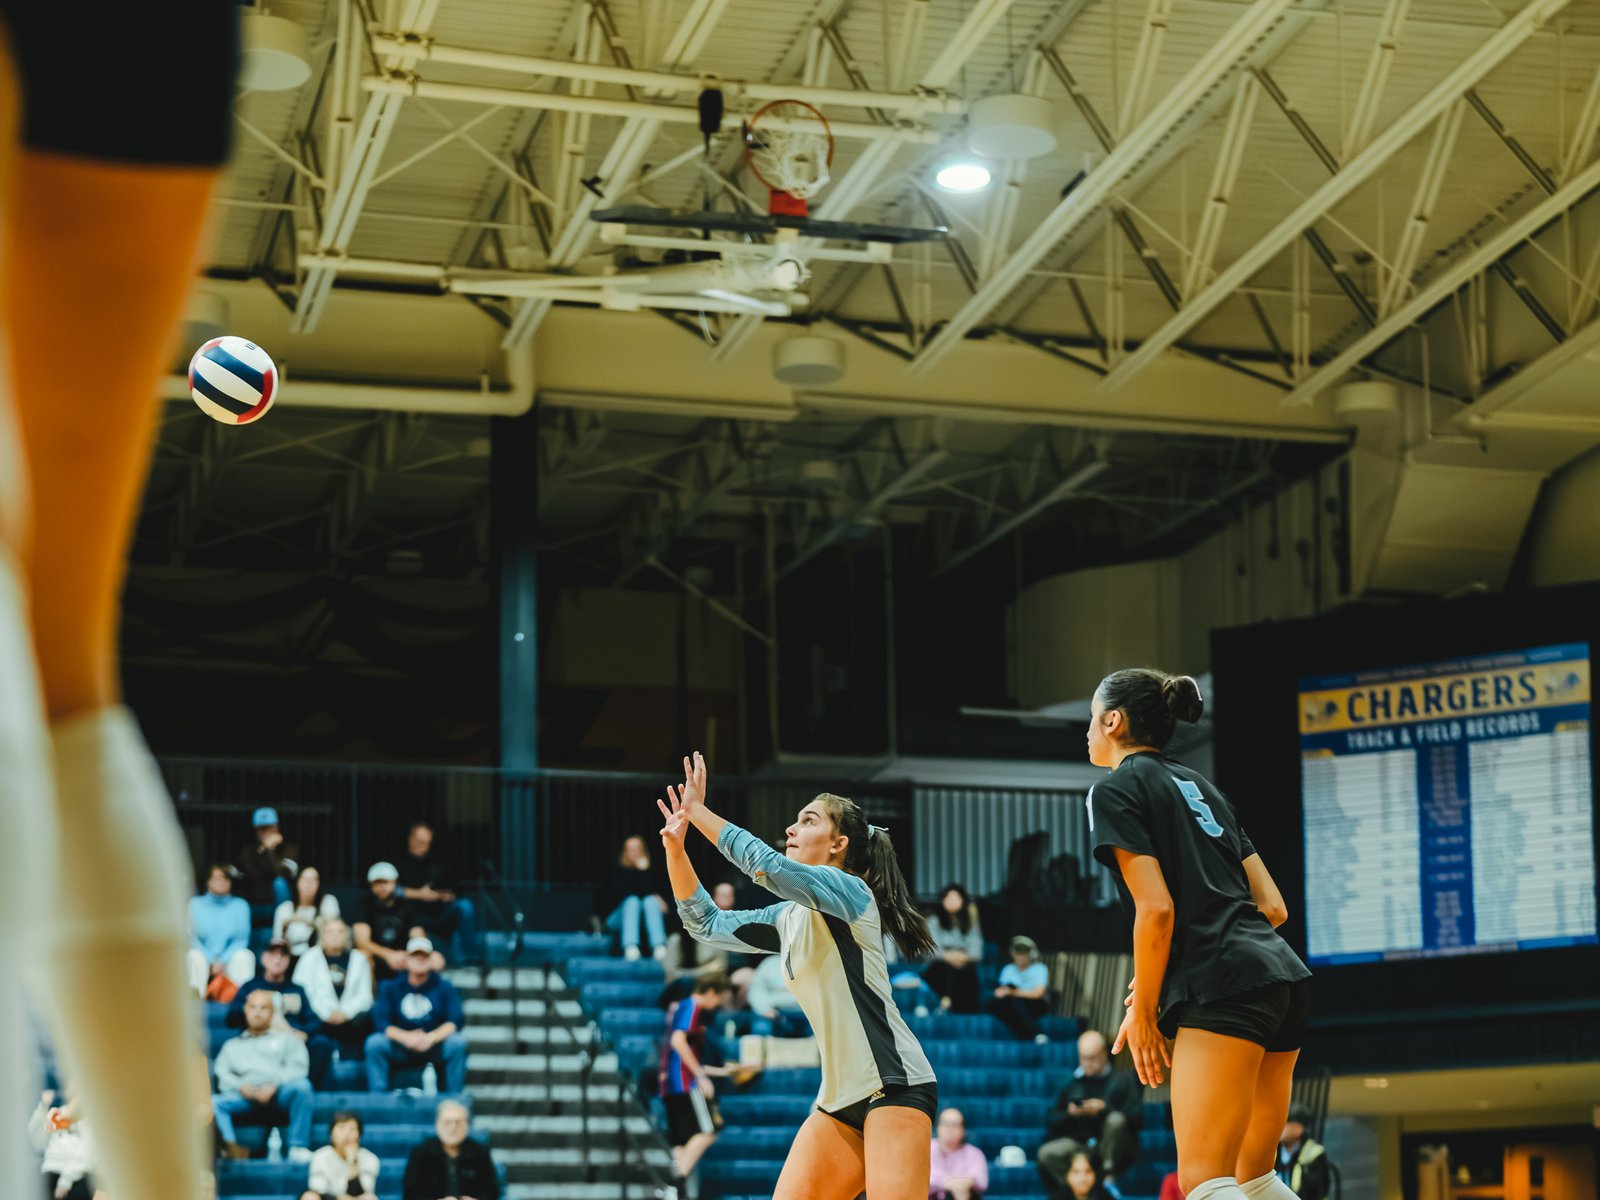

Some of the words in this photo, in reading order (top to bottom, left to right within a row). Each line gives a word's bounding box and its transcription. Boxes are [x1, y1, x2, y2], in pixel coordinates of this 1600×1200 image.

[1347, 671, 1537, 722] CHARGERS
[1347, 730, 1394, 748] TRACK
[1401, 728, 1411, 744] &
[1417, 722, 1461, 742] FIELD
[1466, 713, 1540, 736] RECORDS
[1171, 776, 1224, 837] 5
